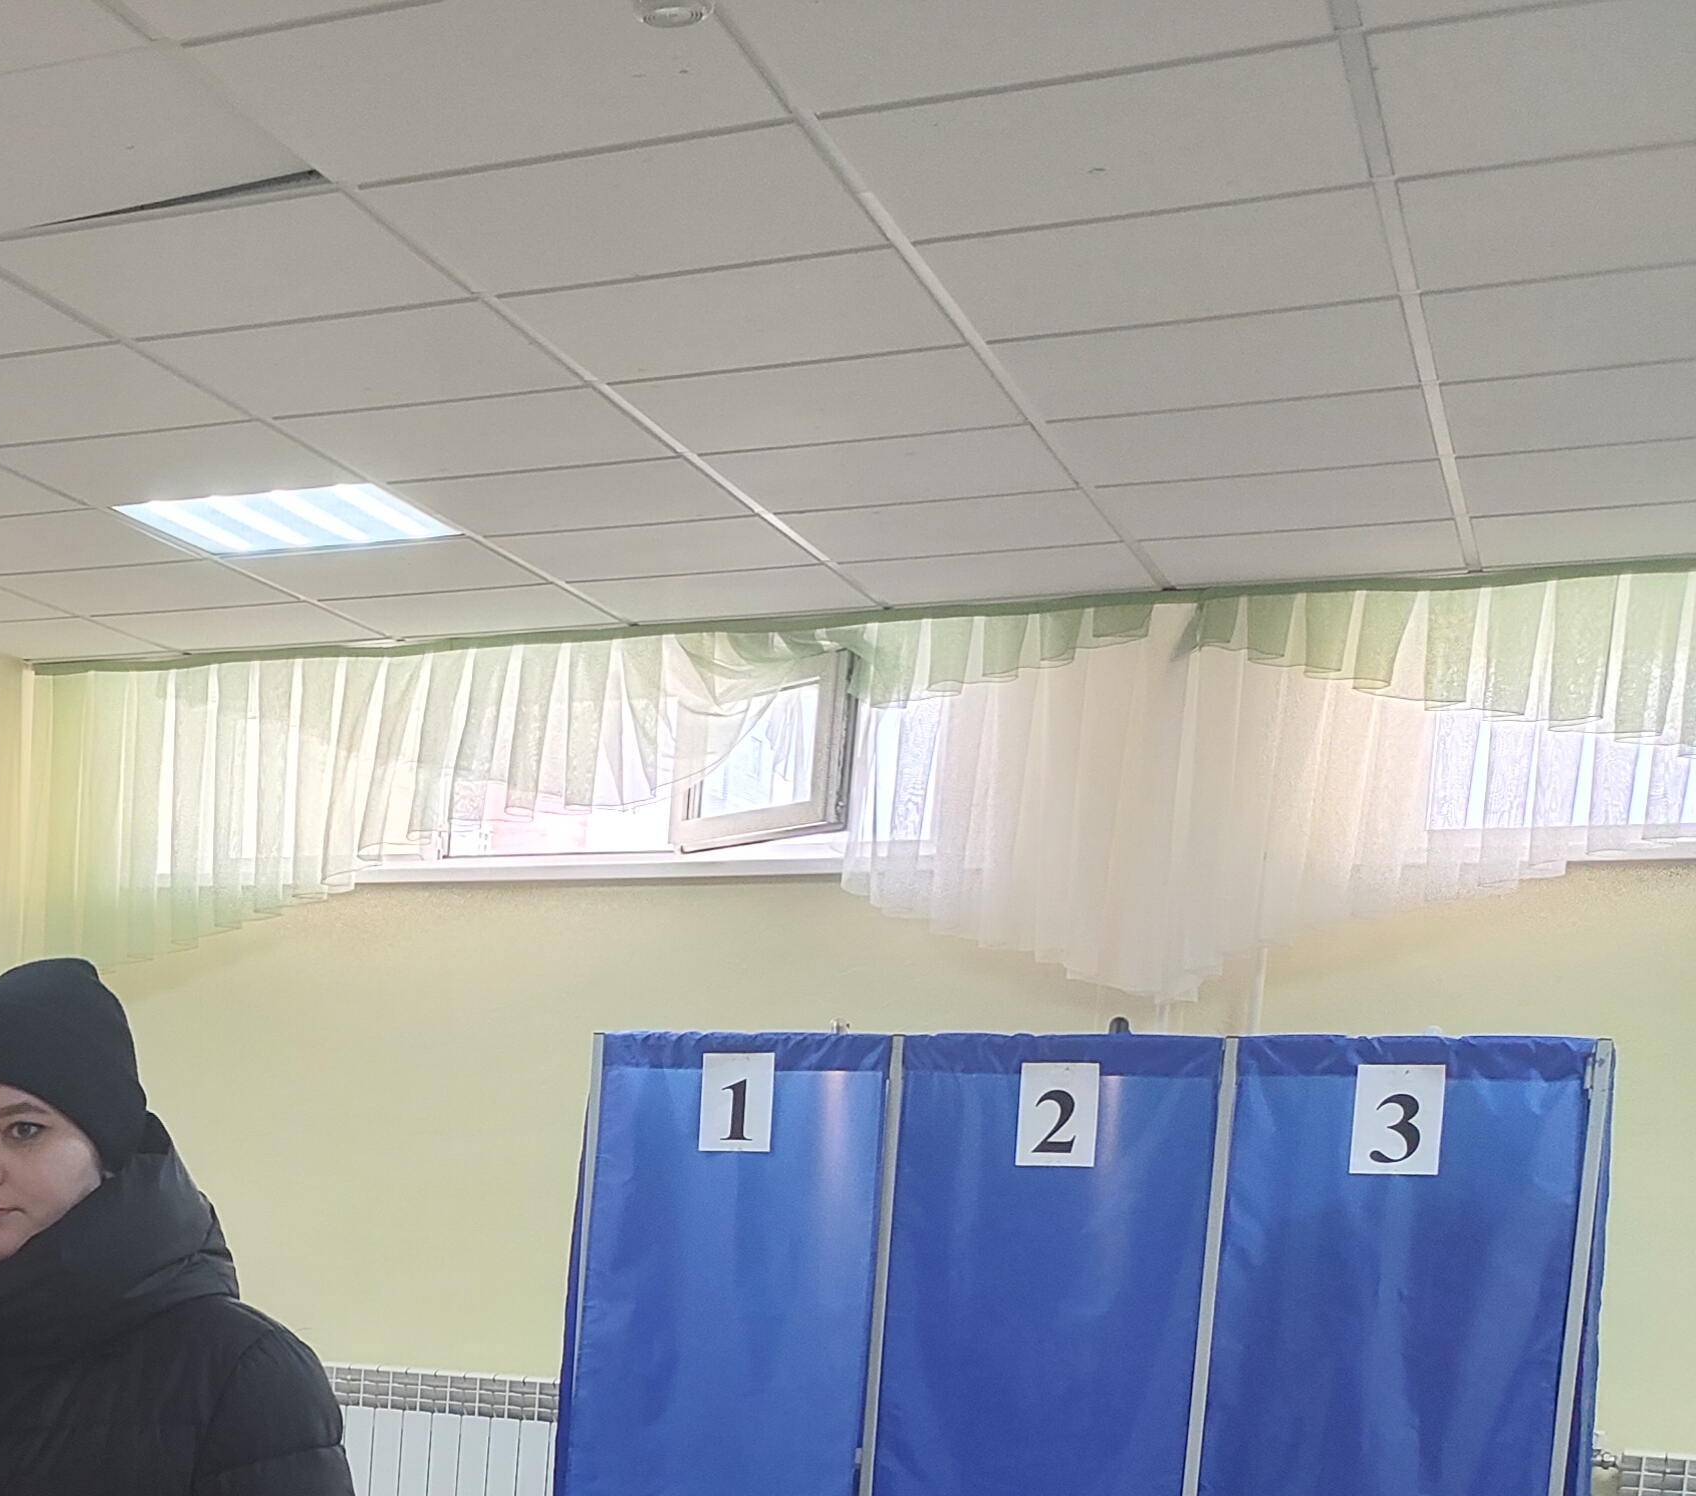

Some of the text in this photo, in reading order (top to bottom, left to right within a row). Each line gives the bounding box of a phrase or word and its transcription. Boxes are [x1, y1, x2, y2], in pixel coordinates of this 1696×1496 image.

[720, 1077, 753, 1142] 1
[1030, 1088, 1078, 1156] 2
[1367, 1092, 1423, 1165] 3
